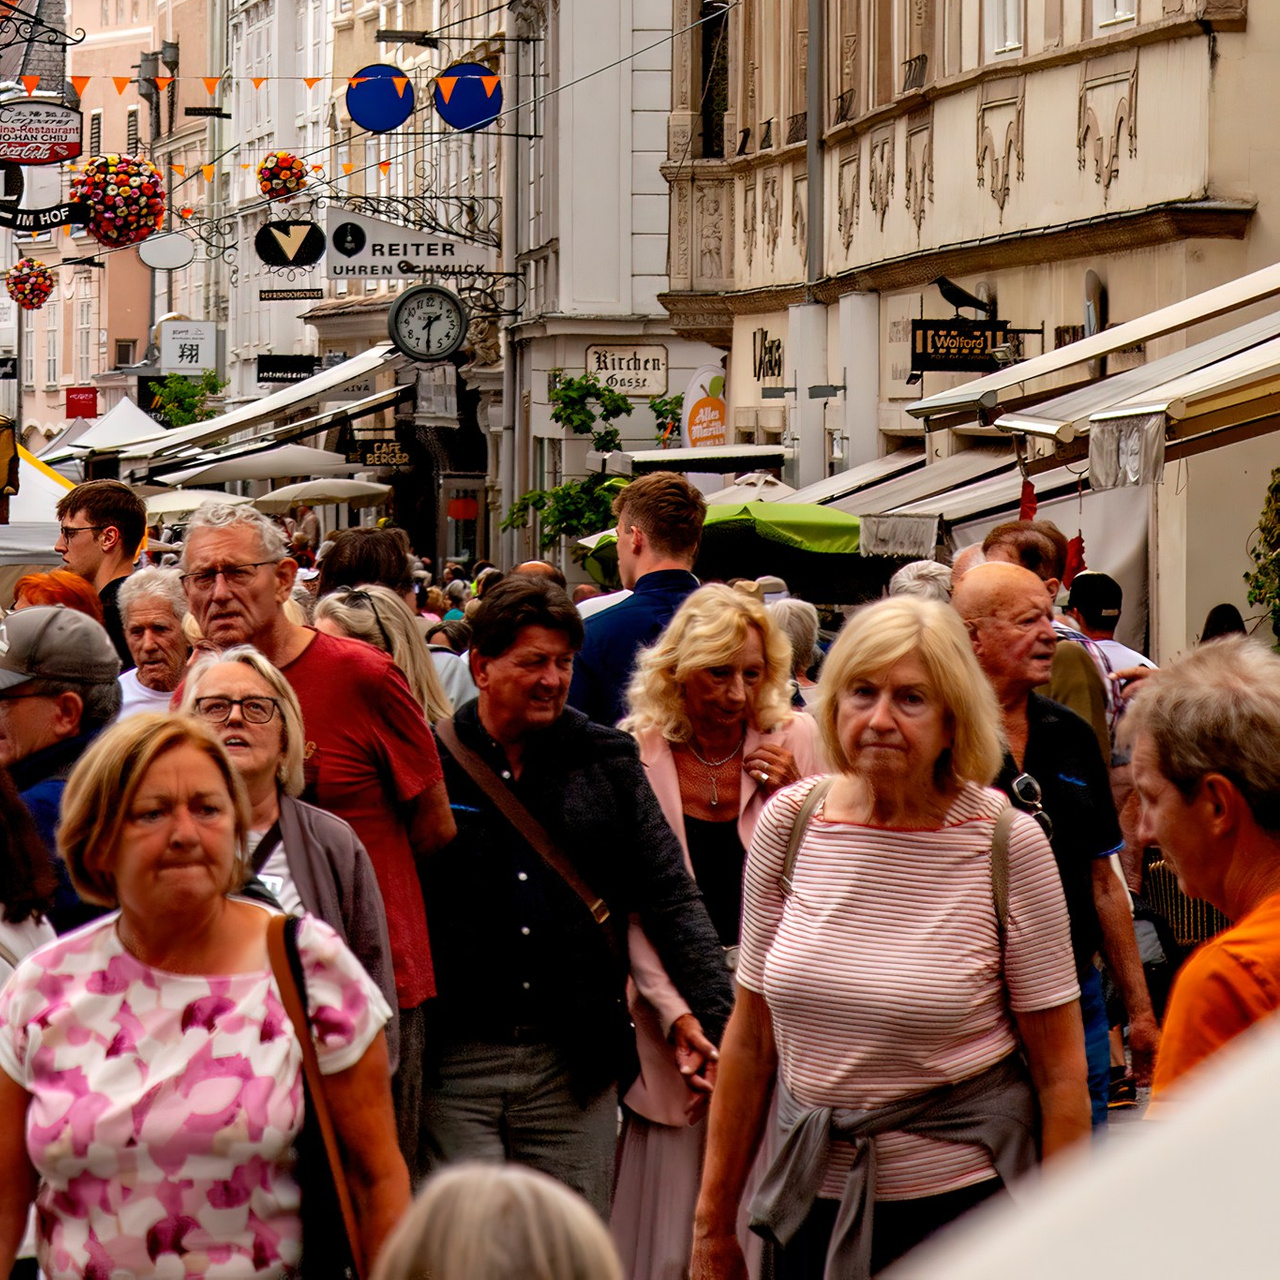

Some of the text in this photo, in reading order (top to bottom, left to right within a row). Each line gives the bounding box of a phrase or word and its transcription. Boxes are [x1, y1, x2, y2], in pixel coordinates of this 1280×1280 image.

[40, 133, 68, 142] CHIU
[16, 207, 70, 227] IM HOF
[371, 243, 455, 256] REITER
[333, 264, 485, 275] UHREN CHMUCK
[934, 335, 984, 349] Wolford
[593, 350, 666, 372] Kirchen-
[366, 453, 409, 465] BERGER
